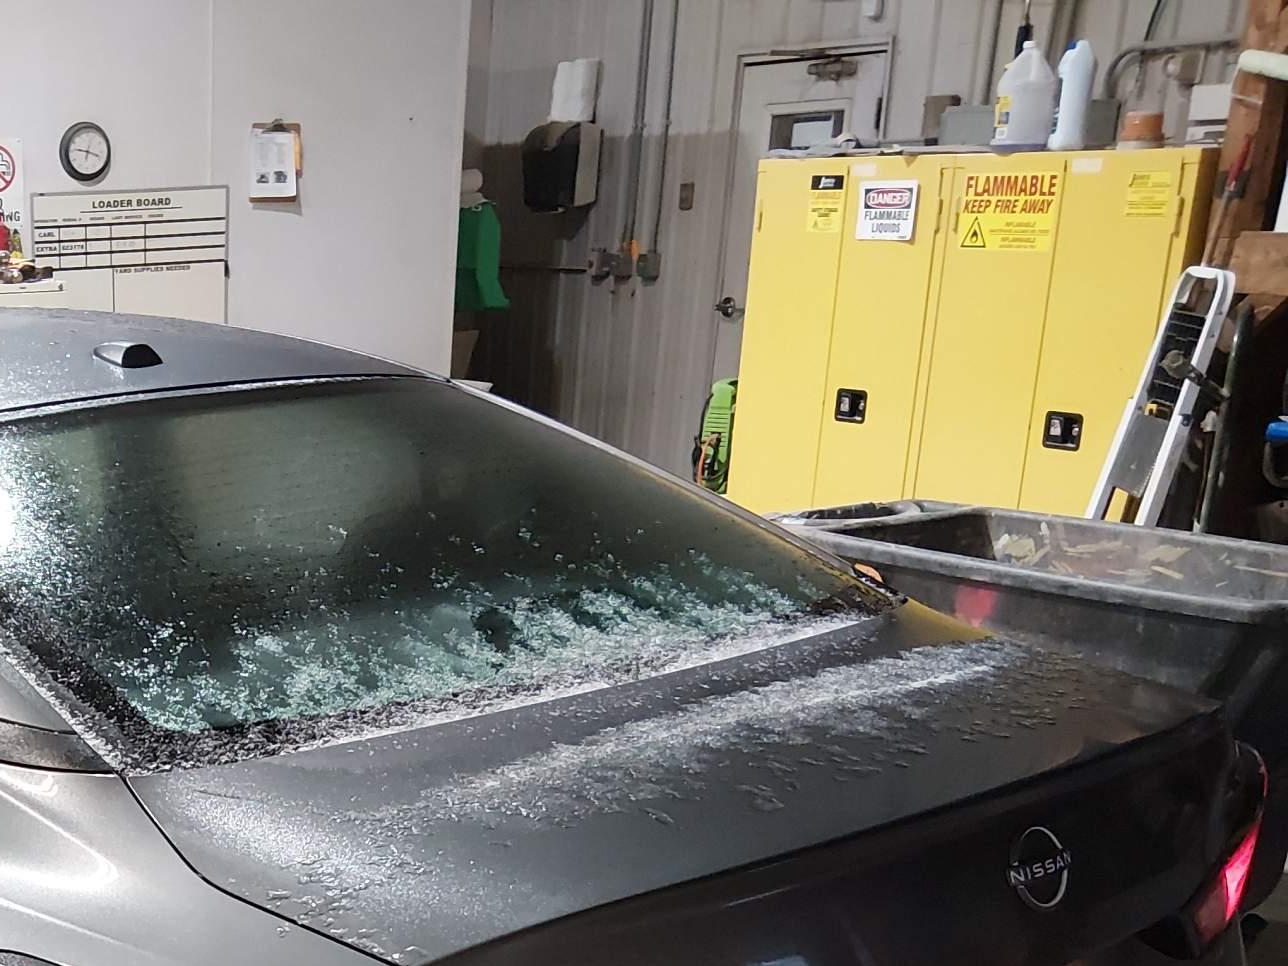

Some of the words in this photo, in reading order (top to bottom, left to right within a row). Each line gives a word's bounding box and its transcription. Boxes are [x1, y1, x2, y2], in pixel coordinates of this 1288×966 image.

[965, 175, 1058, 197] FLAMMABLE
[92, 199, 133, 209] LOADER
[136, 197, 171, 207] BOARD
[870, 193, 909, 204] DANGER
[963, 199, 992, 213] KEEP
[993, 199, 1019, 213] FIRE
[1019, 199, 1054, 213] AWAY
[864, 210, 910, 220] FLAMMABLE
[871, 222, 901, 233] LIQUIDS
[1010, 850, 1072, 885] NISSAN
